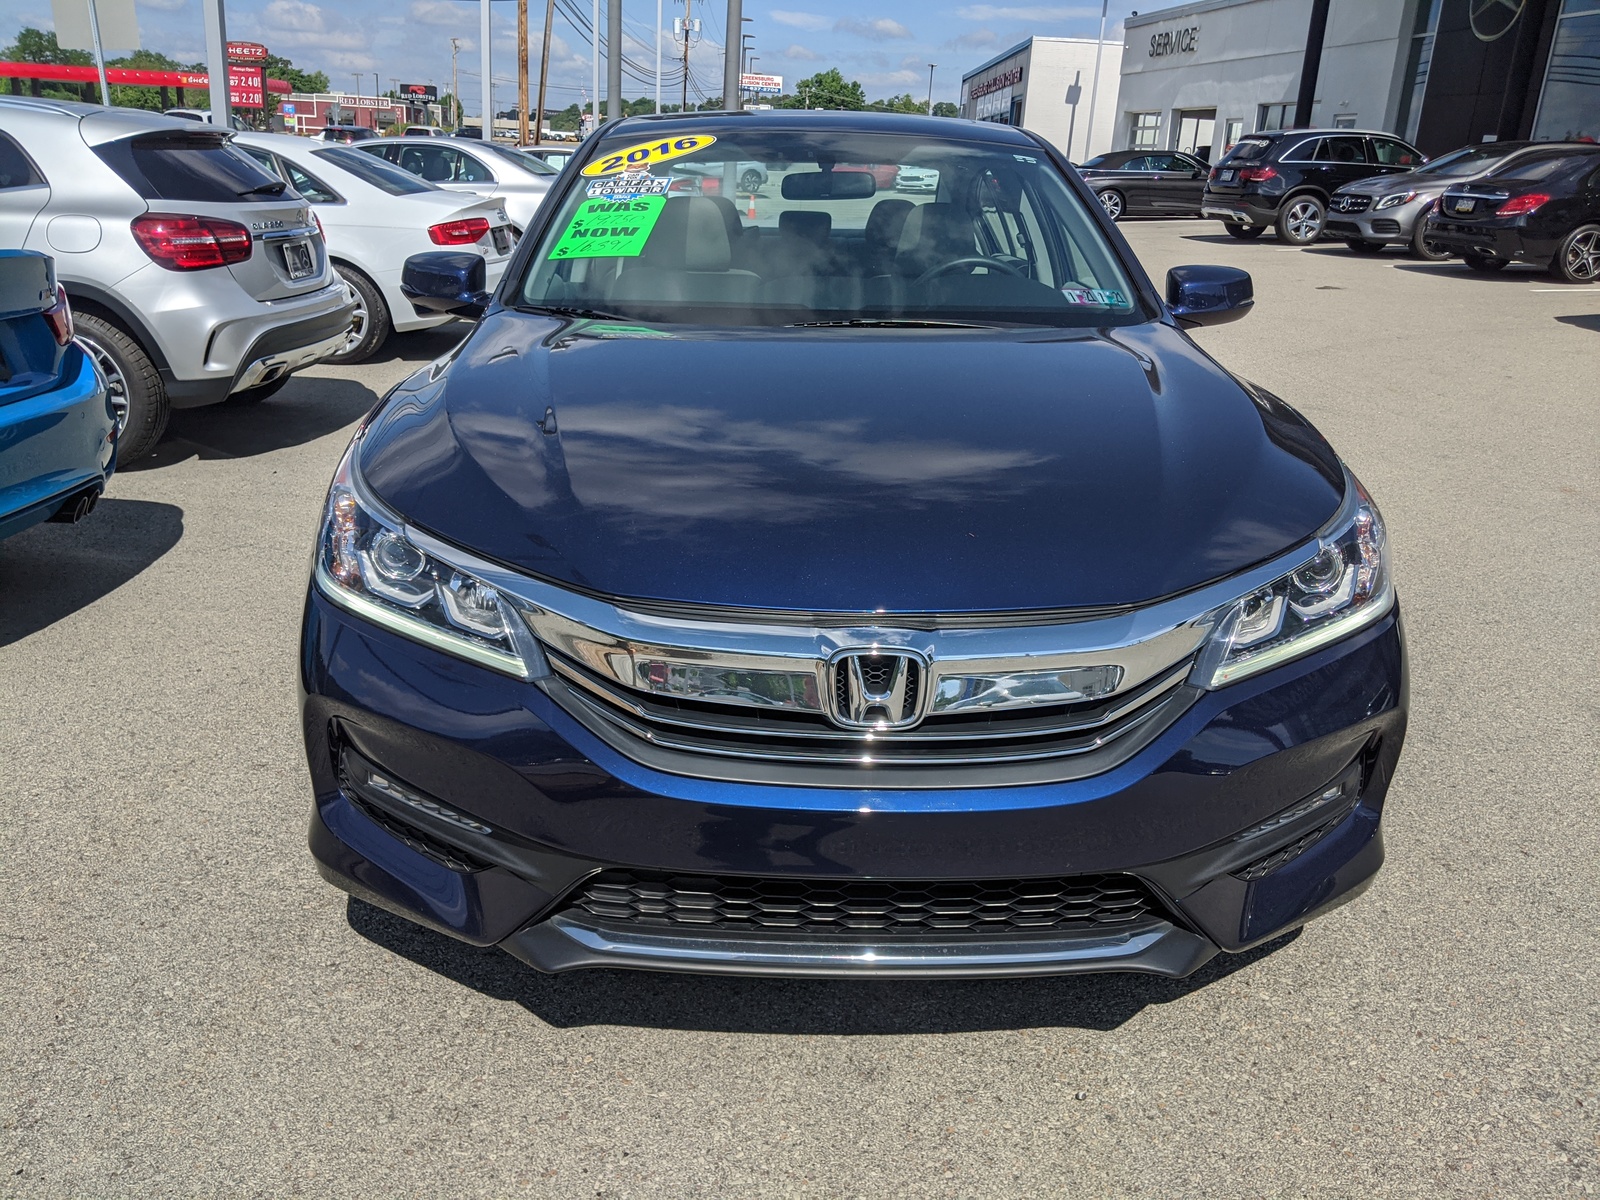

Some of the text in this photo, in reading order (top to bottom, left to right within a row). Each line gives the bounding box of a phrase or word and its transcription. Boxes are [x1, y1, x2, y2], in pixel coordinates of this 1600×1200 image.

[1149, 27, 1198, 57] SERVICE
[228, 47, 263, 56] HEETZ
[241, 77, 258, 87] 2.40
[242, 93, 259, 103] 2.20
[356, 97, 389, 107] LOBSTER
[412, 93, 436, 101] LOBSTER
[601, 138, 699, 173] 2016
[594, 180, 666, 188] CARFAX
[602, 186, 662, 194] OWNER
[588, 202, 651, 214] WAS
[572, 219, 585, 230] $
[571, 227, 641, 239] NOW
[557, 247, 570, 257] $
